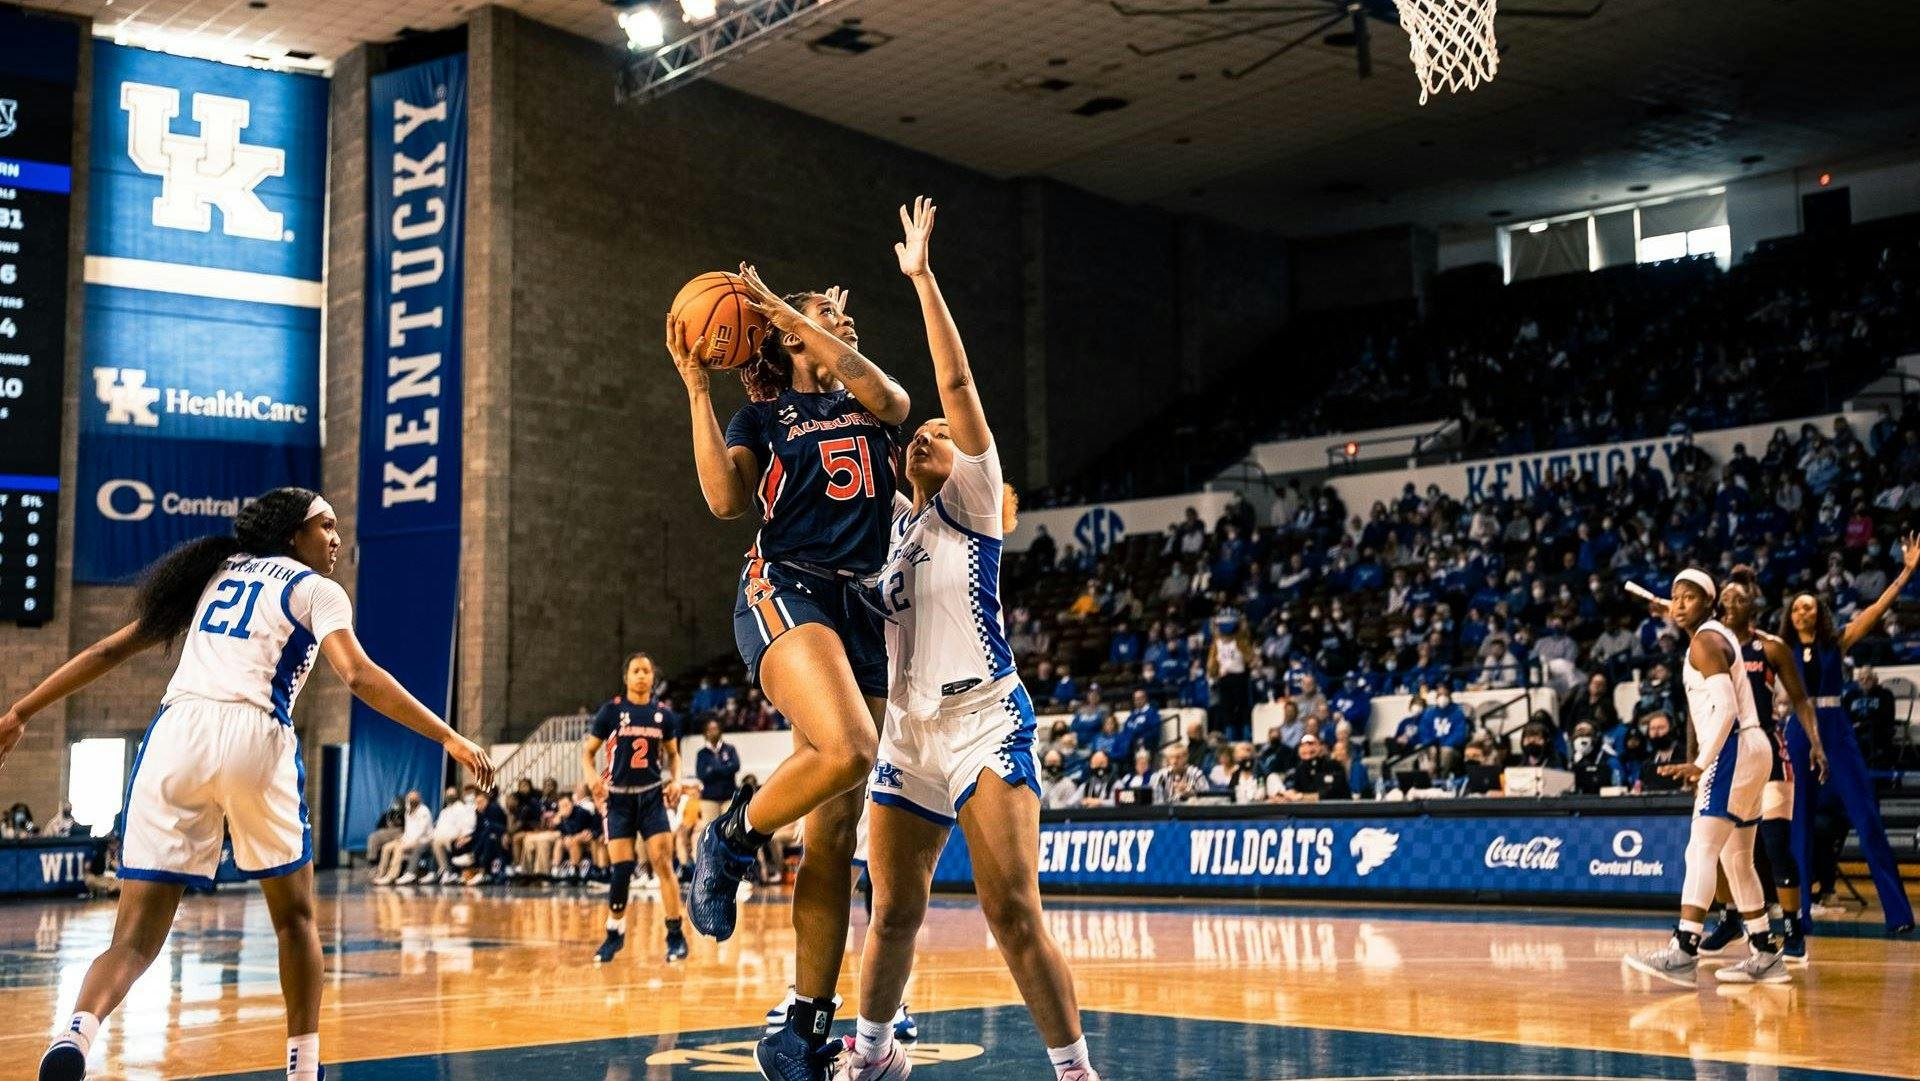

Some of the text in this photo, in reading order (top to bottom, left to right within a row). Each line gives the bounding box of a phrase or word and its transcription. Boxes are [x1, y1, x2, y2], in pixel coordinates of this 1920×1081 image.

[0, 162, 20, 178] RN
[120, 81, 286, 242] UK
[0, 264, 18, 285] 6
[382, 98, 448, 509] KENTUCKY
[93, 367, 308, 428] UK HealthCare
[786, 412, 881, 442] AUBURN
[818, 436, 875, 501] 51
[162, 492, 239, 518] Central
[199, 578, 264, 640] 21
[630, 738, 649, 769] 2
[1038, 827, 1334, 876] ENTUCKY WILDCATS
[1589, 859, 1664, 876] Central Bank
